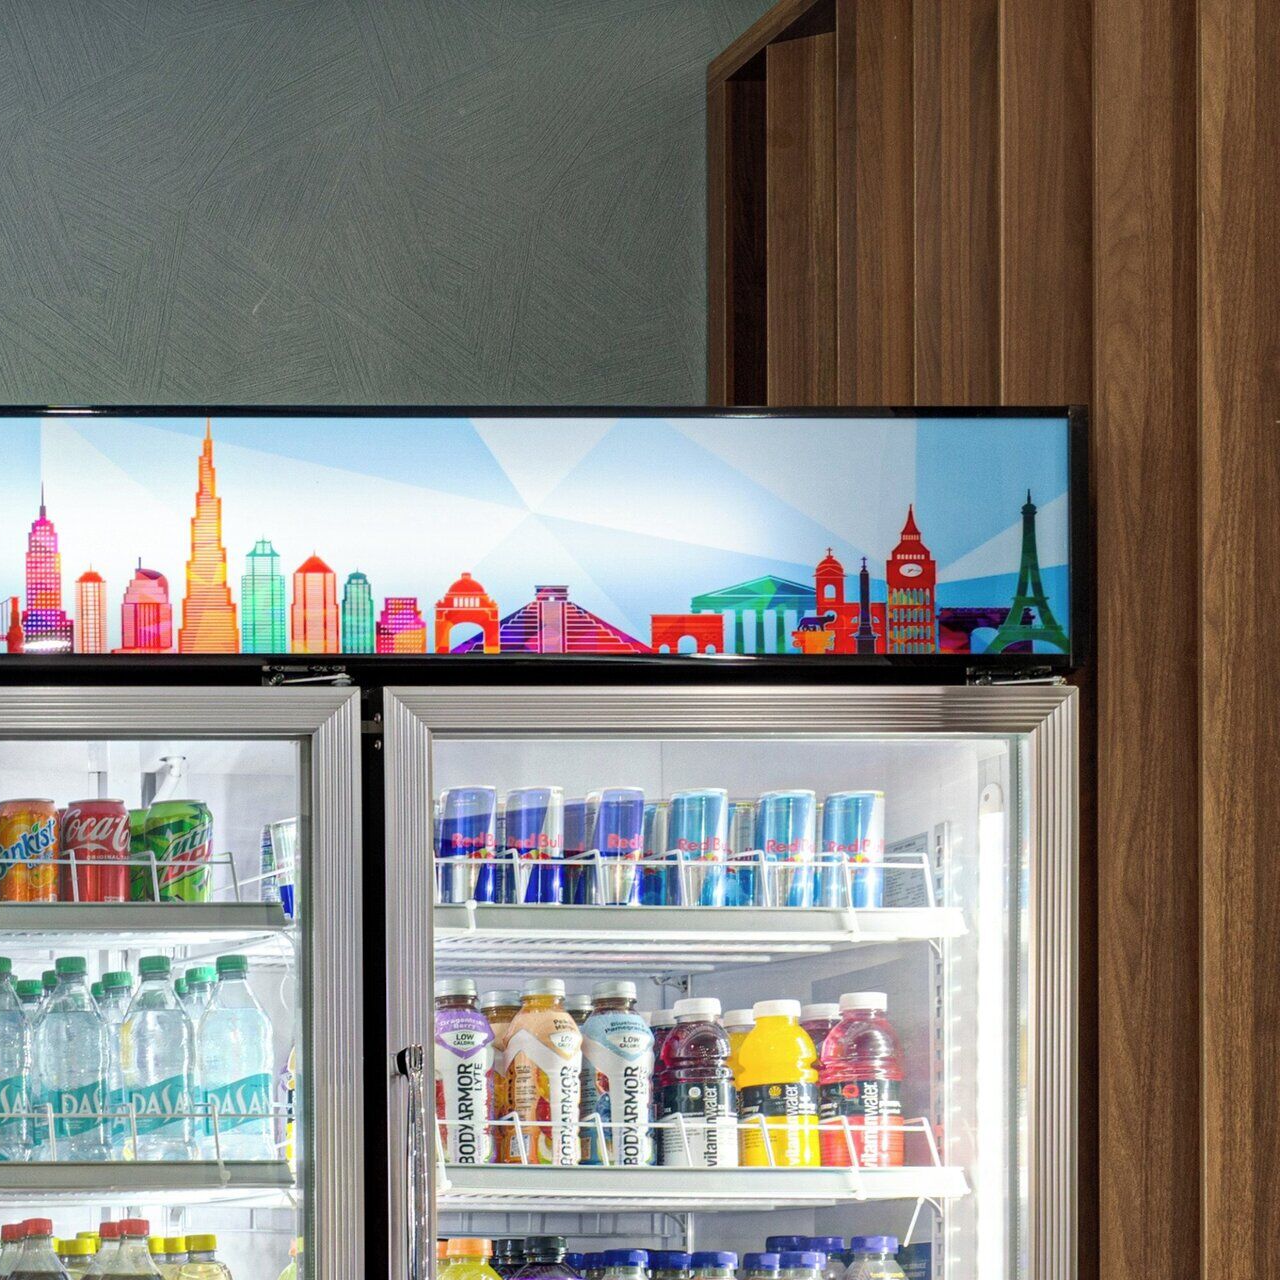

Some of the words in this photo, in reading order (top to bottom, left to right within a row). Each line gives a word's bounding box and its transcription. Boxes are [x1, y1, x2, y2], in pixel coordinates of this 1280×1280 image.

[451, 832, 484, 848] Red
[474, 1063, 482, 1091] LYTE
[458, 1063, 475, 1164] BODYARMOR
[624, 1066, 639, 1165] BODYARMOR
